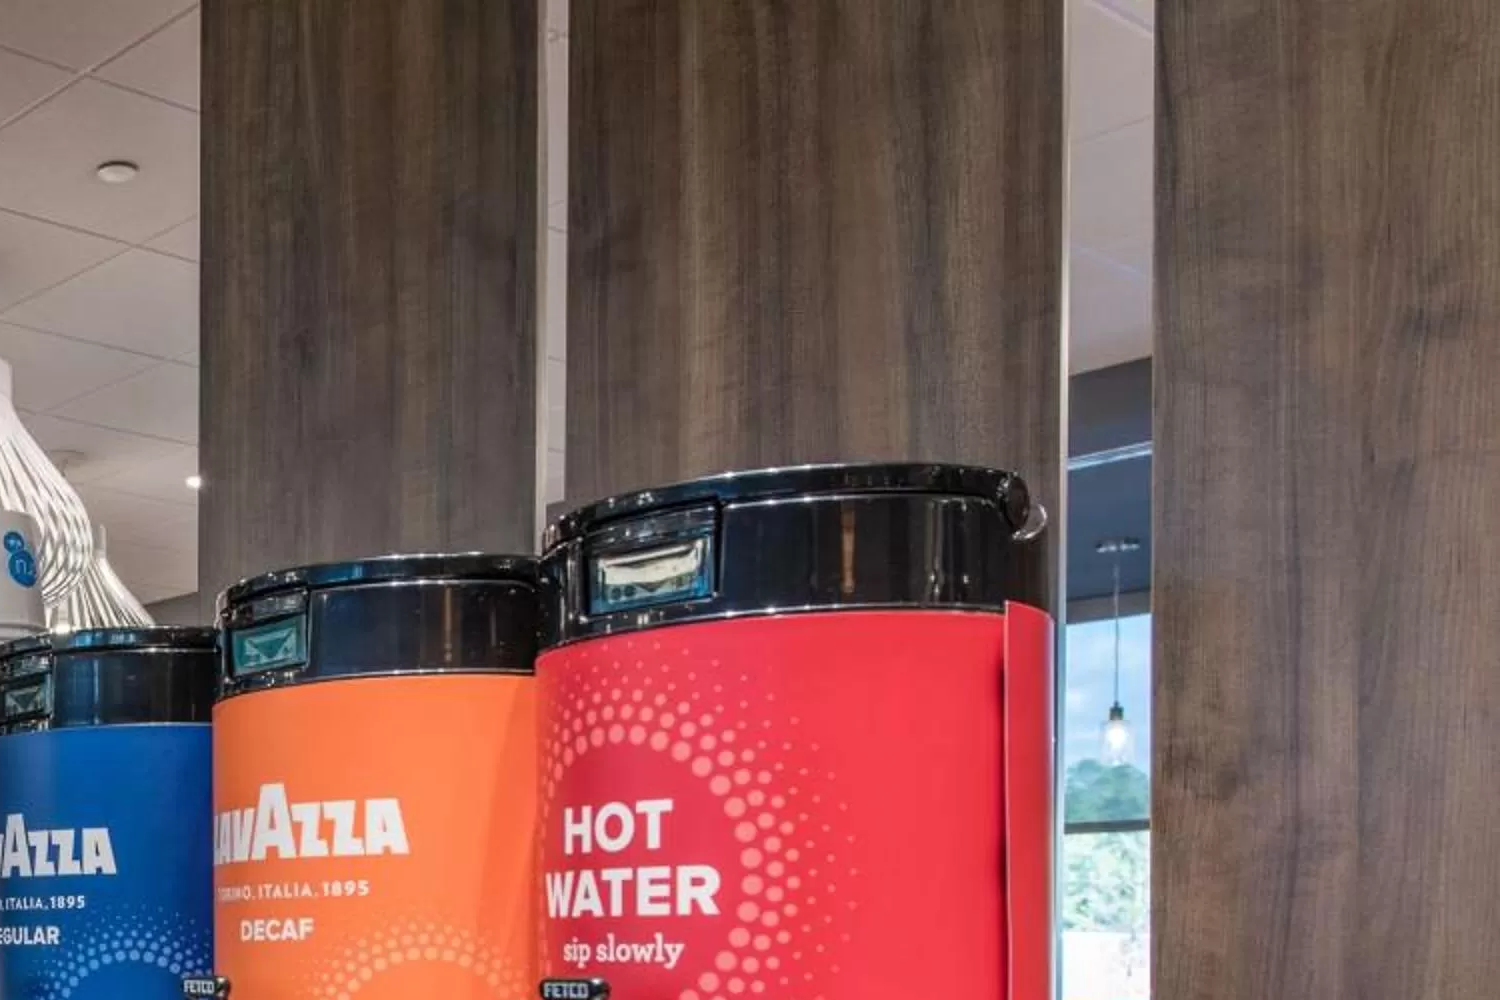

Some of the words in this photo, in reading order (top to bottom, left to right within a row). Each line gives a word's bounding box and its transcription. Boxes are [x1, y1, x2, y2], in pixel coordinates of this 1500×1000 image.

[564, 798, 674, 855] HOT
[323, 878, 371, 899] 1895
[545, 864, 721, 919] WATER
[50, 894, 86, 911] 1895
[240, 916, 315, 943] DECAF
[563, 934, 592, 969] sip
[595, 931, 685, 970] slowly
[543, 982, 589, 1000] FETCO
